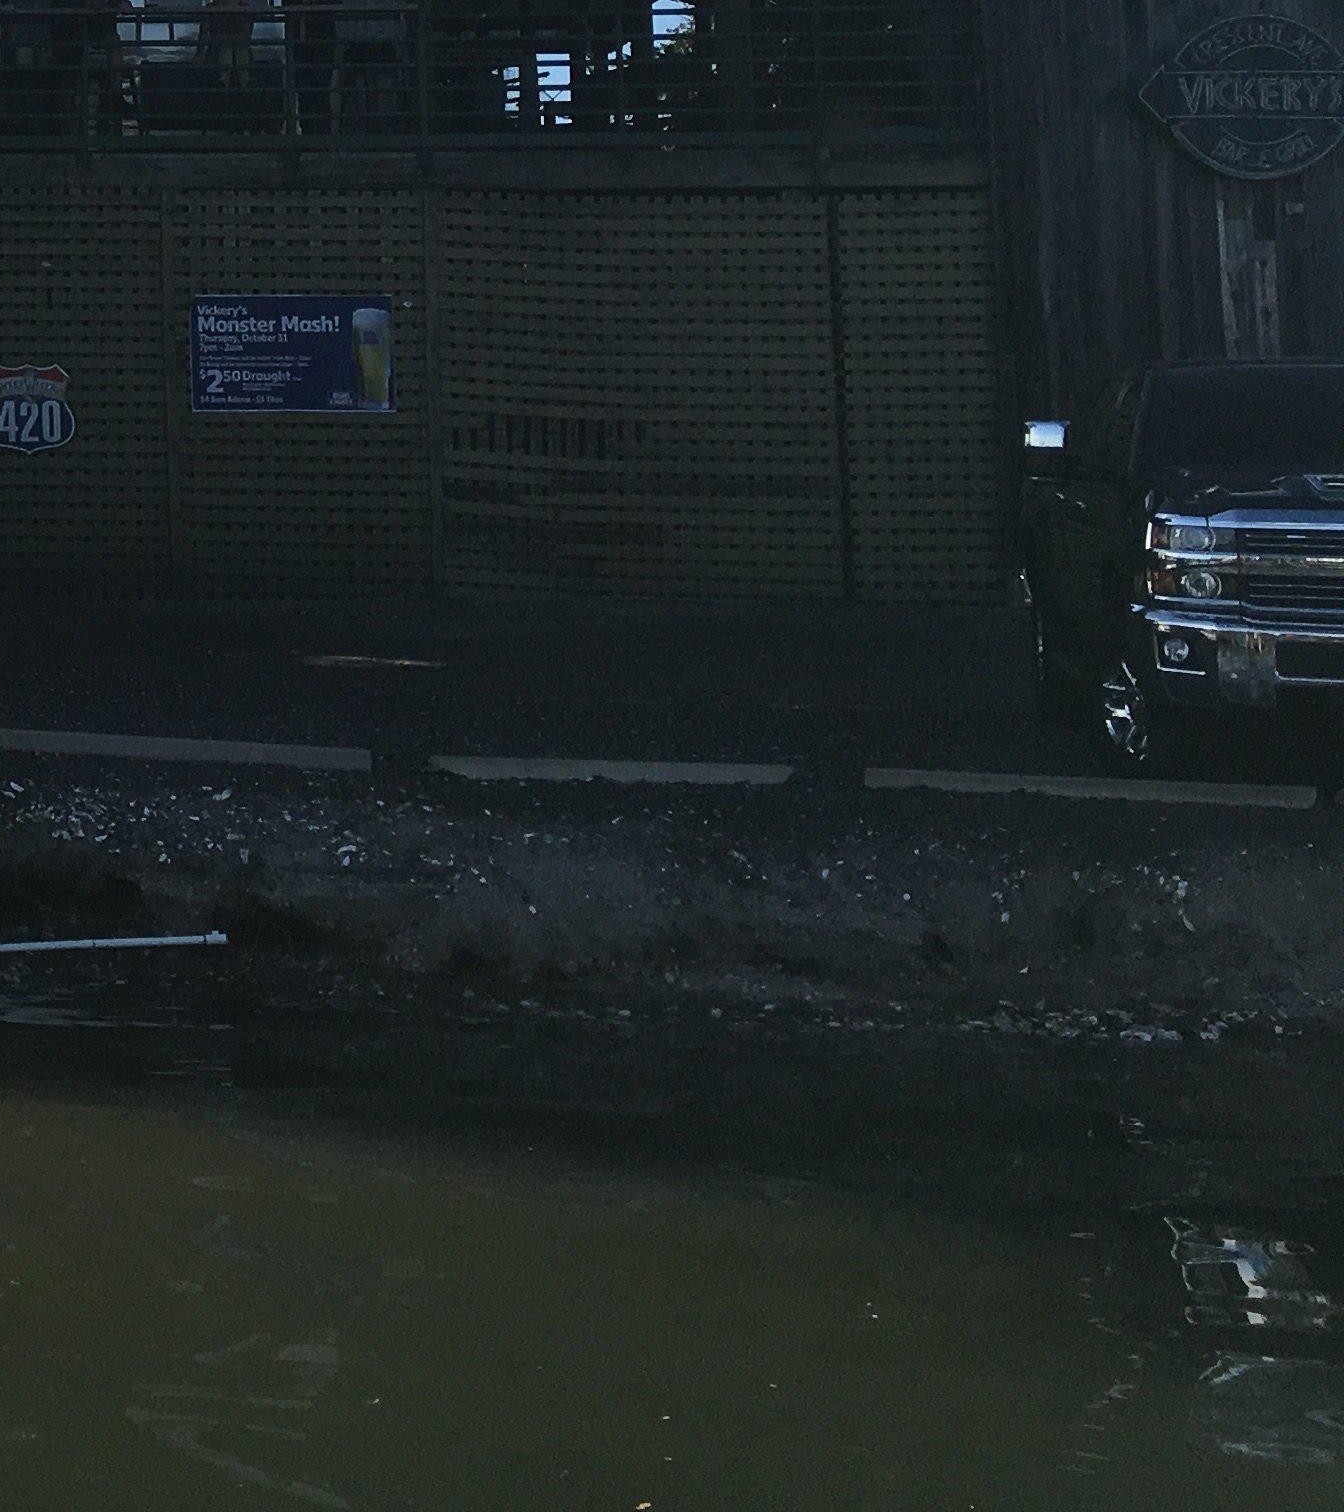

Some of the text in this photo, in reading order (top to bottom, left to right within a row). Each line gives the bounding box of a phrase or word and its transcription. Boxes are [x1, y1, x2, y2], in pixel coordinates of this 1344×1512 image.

[197, 305, 247, 317] Vickery's
[197, 316, 339, 333] Monster Mash!
[241, 333, 276, 343] October
